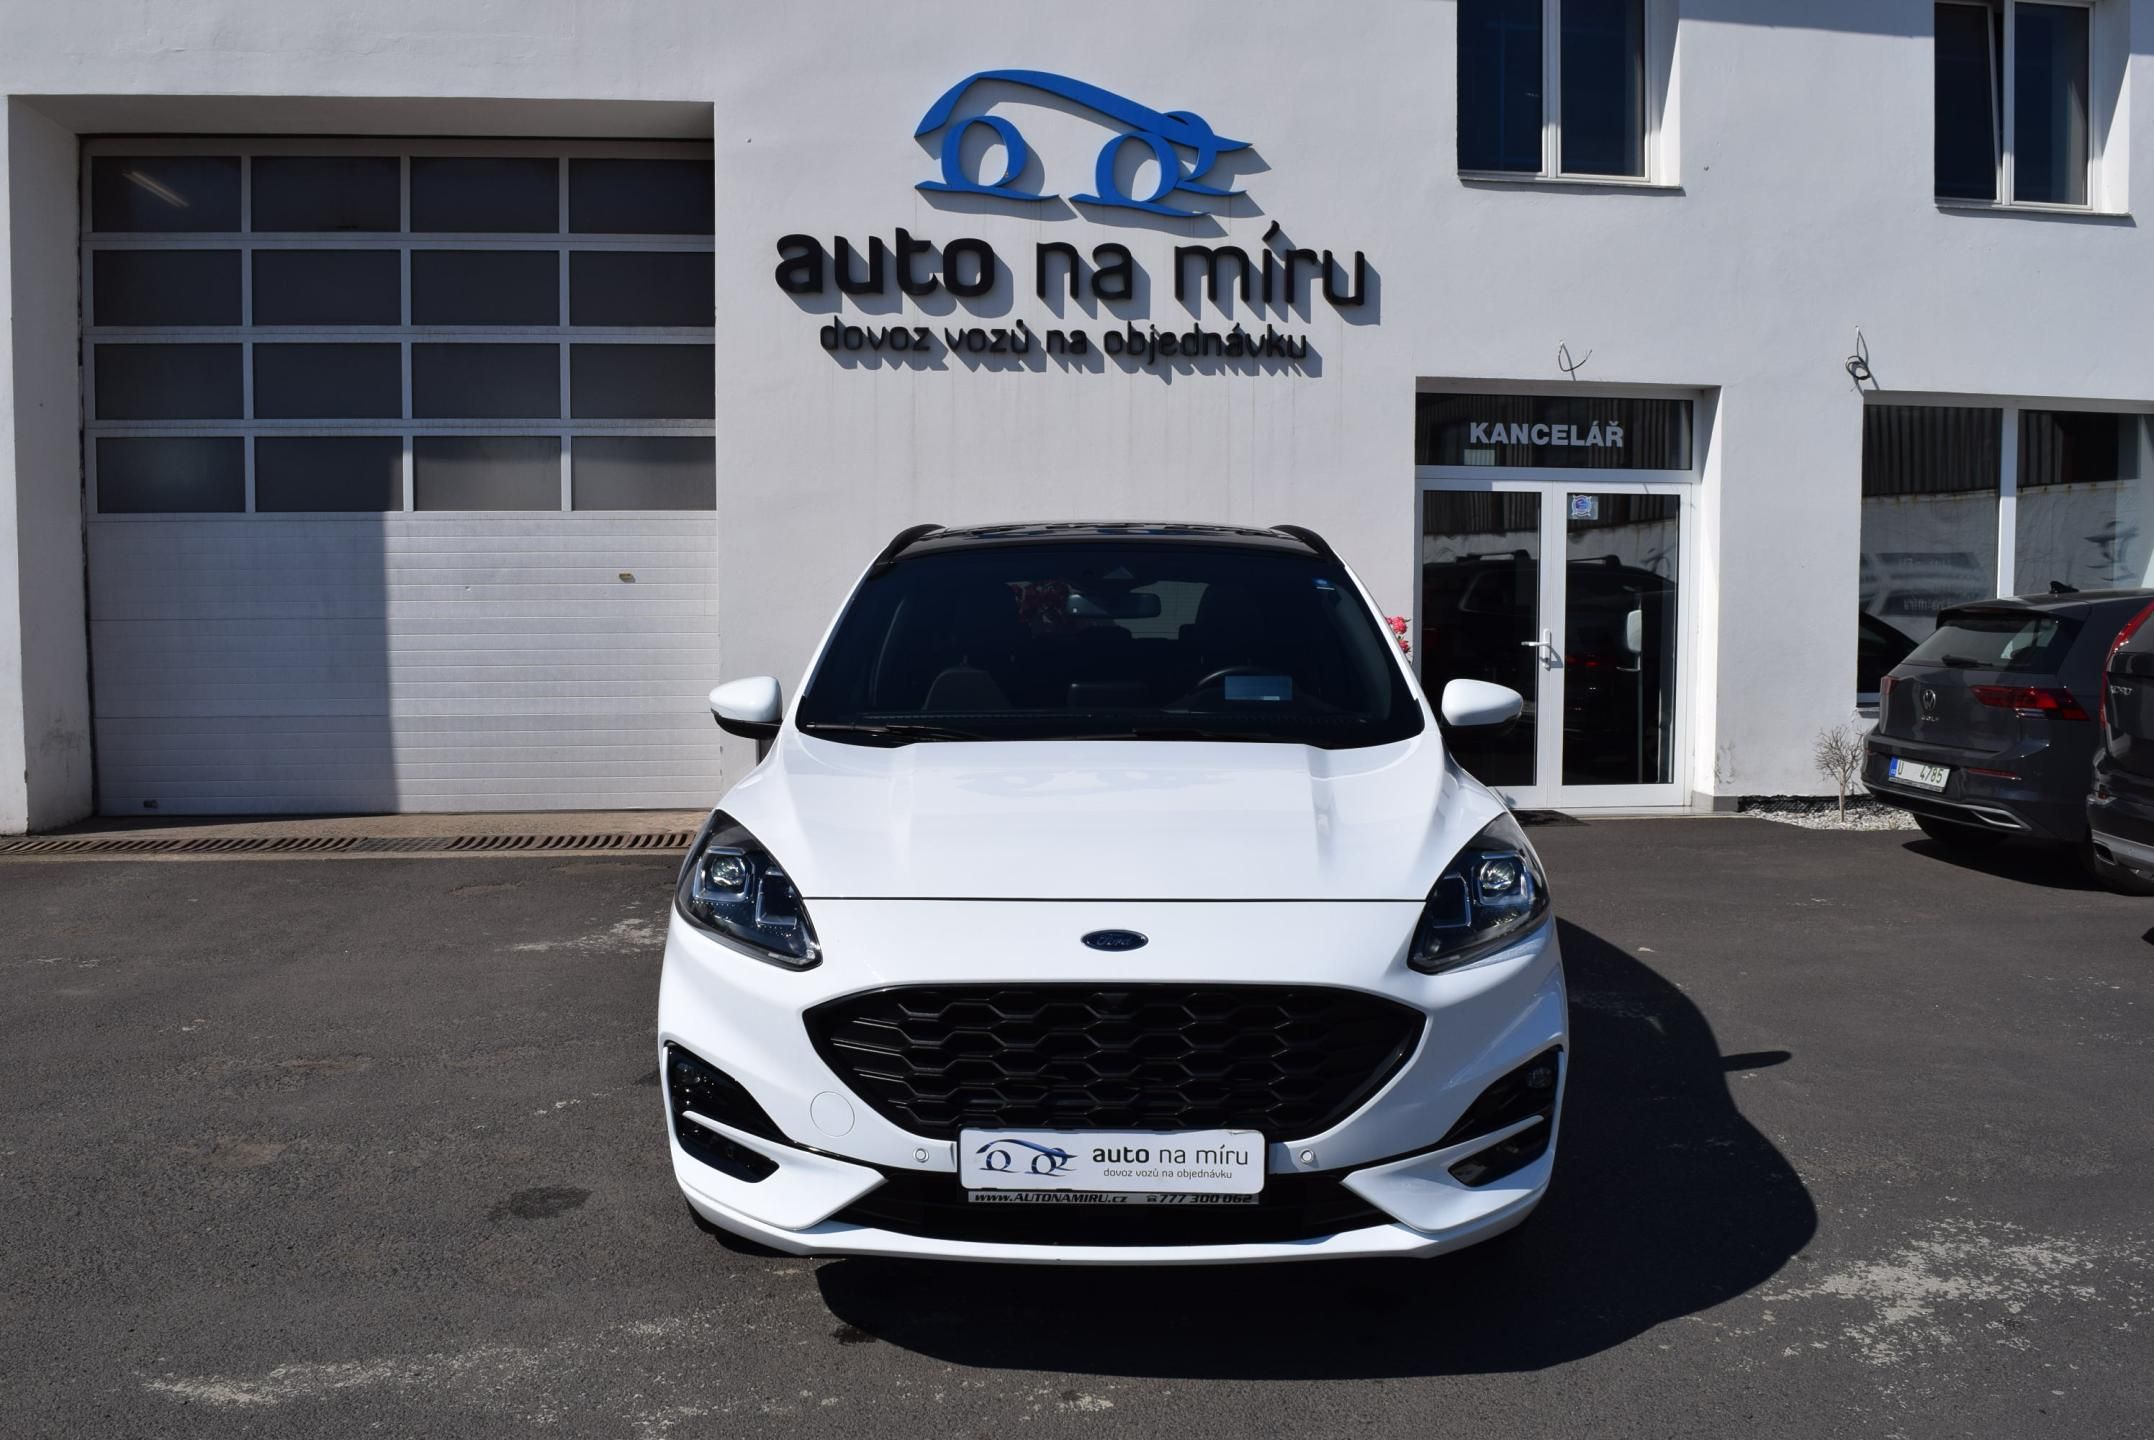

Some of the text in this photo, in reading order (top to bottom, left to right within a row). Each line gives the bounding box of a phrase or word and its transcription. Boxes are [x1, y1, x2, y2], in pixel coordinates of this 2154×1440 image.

[775, 220, 1365, 306] auto na míru
[820, 315, 1307, 366] dovoz vozů na objednávku
[1470, 420, 1624, 448] KANCELÁŘ
[1092, 1144, 1249, 1166] auto na míru
[1103, 1167, 1233, 1180] dovoz vozů na objednávku
[975, 1193, 1128, 1204] www.AUTONAMIRU.cz
[1160, 1194, 1253, 1204] 777 300 062
